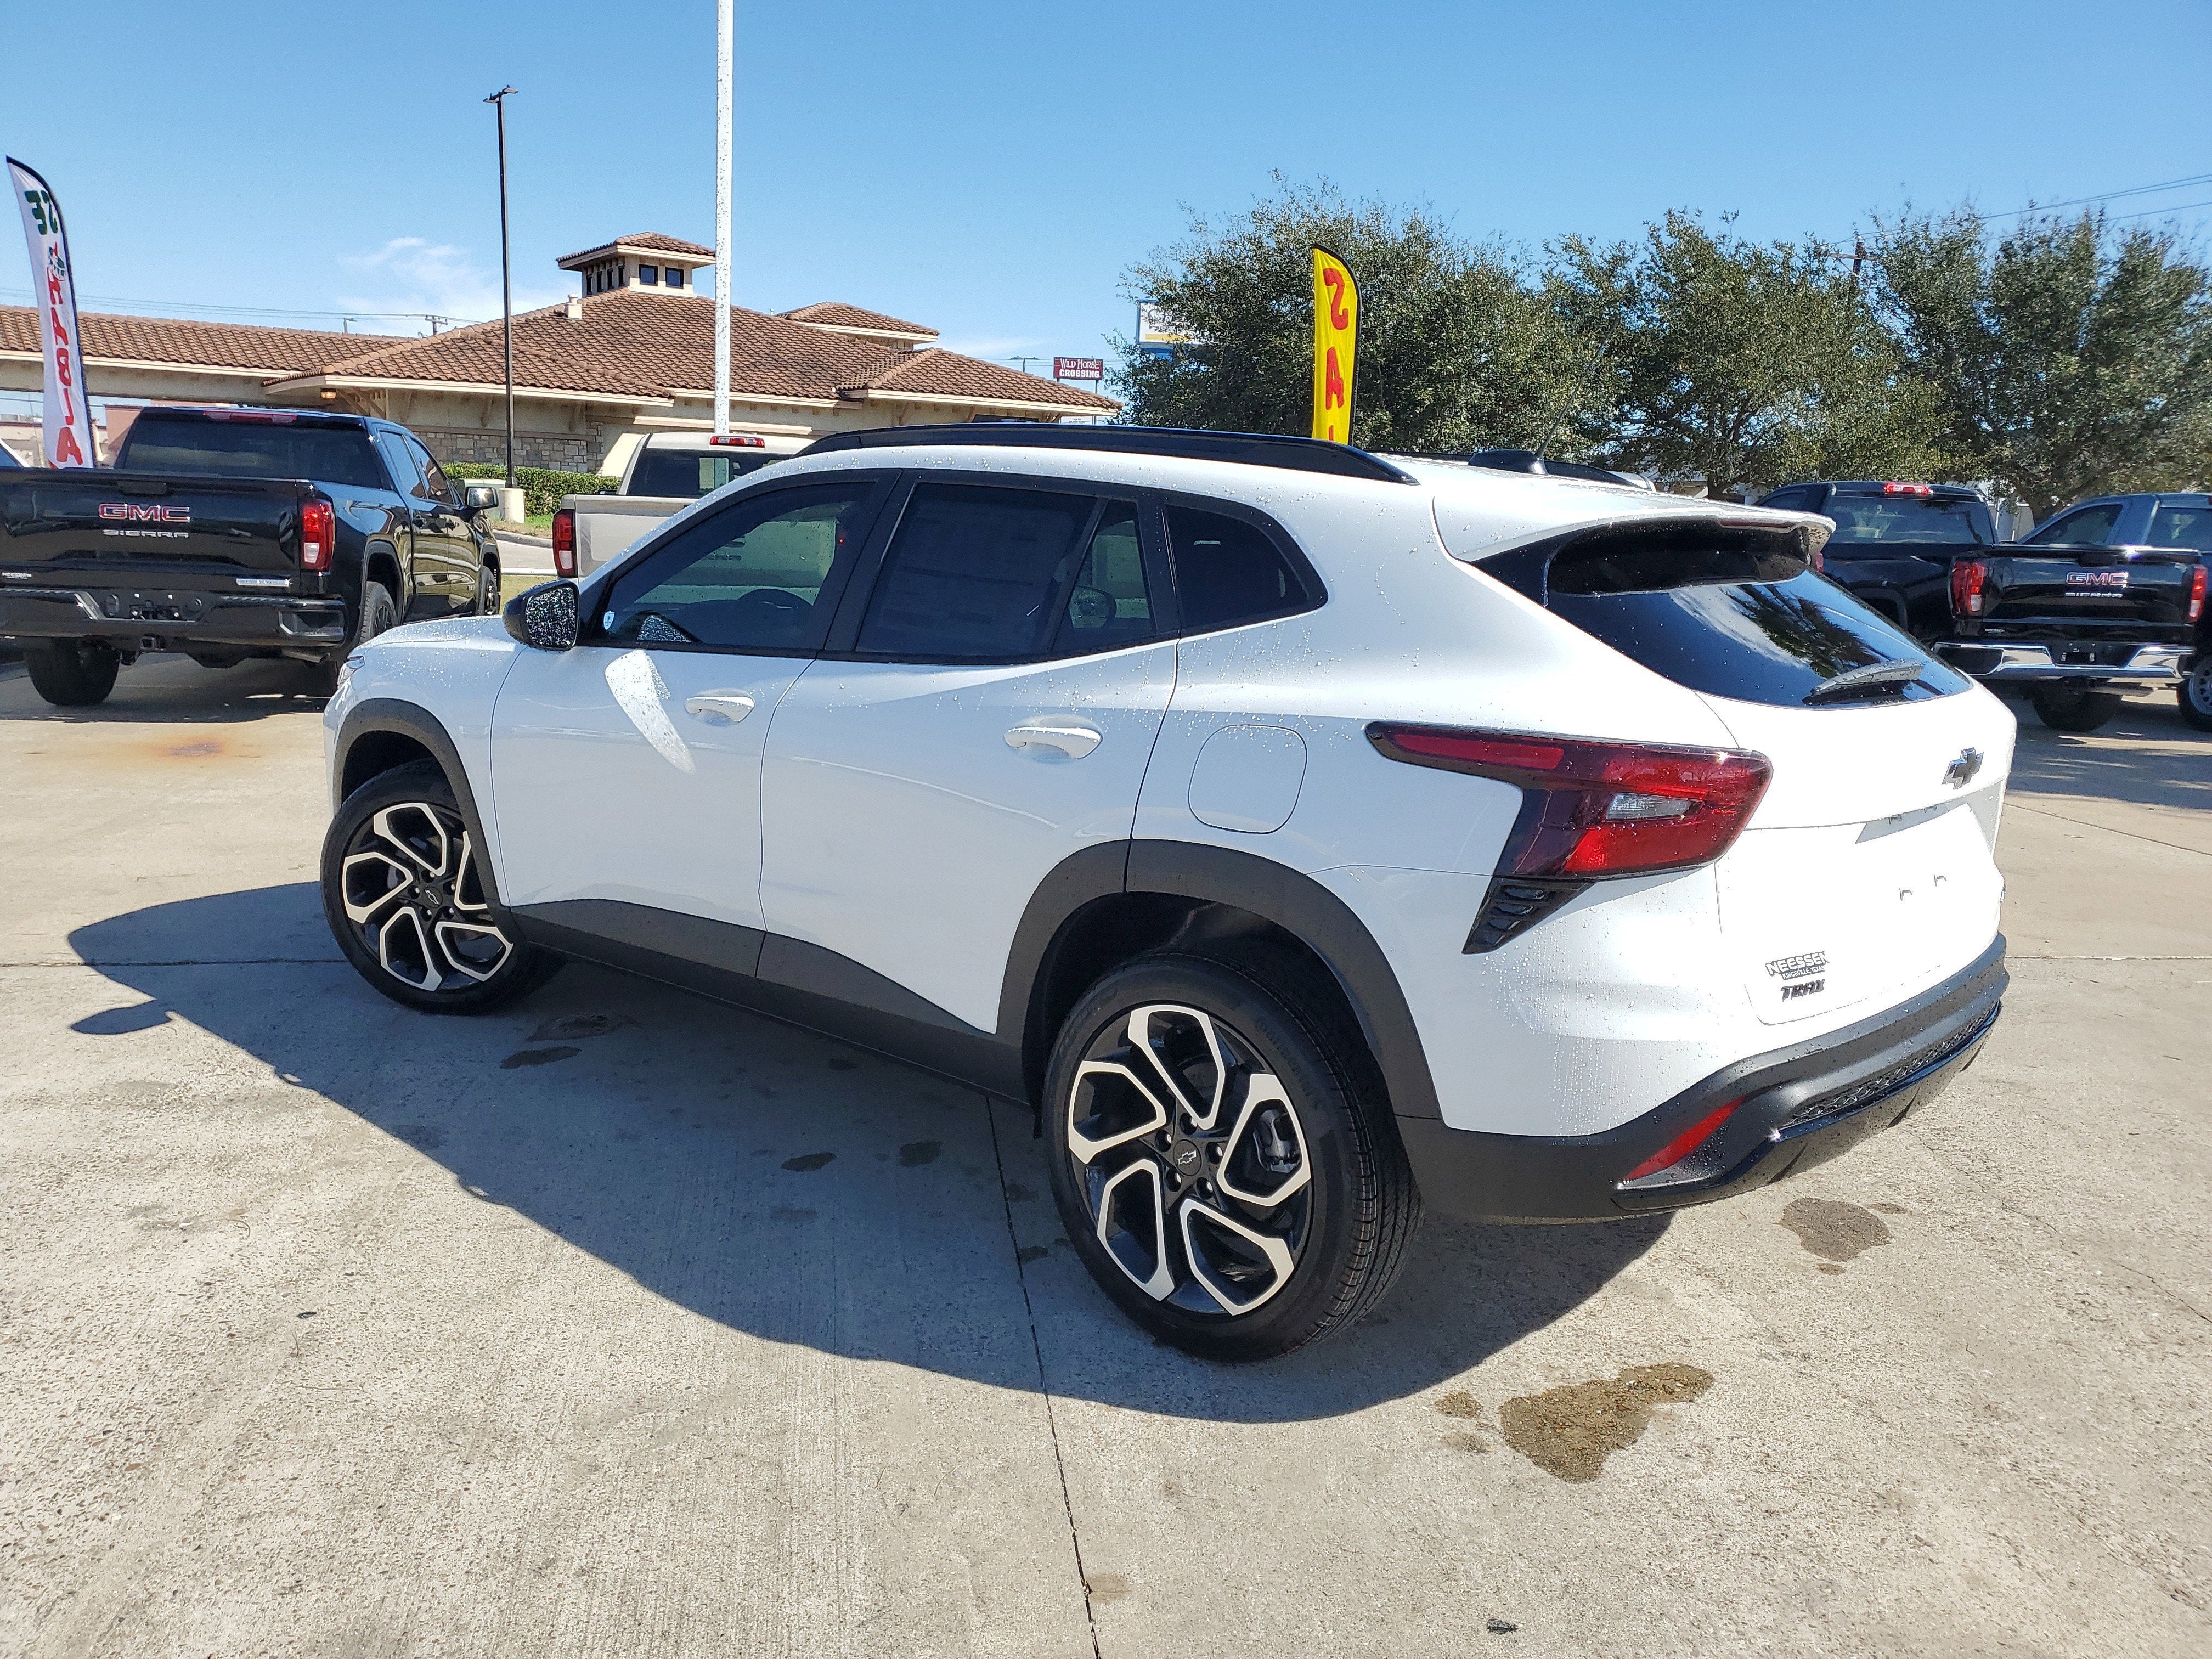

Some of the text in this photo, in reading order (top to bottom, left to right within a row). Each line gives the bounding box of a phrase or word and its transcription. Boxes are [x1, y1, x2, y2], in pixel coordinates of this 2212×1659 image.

[1060, 358, 1099, 369] WILD HORSE
[1059, 369, 1100, 378] CROSSING
[99, 503, 190, 522] GMC
[102, 529, 189, 538] SIERRA
[2066, 572, 2128, 588] GMC
[1765, 951, 1830, 977] NEESSEN
[1780, 979, 1825, 1002] TRAX
